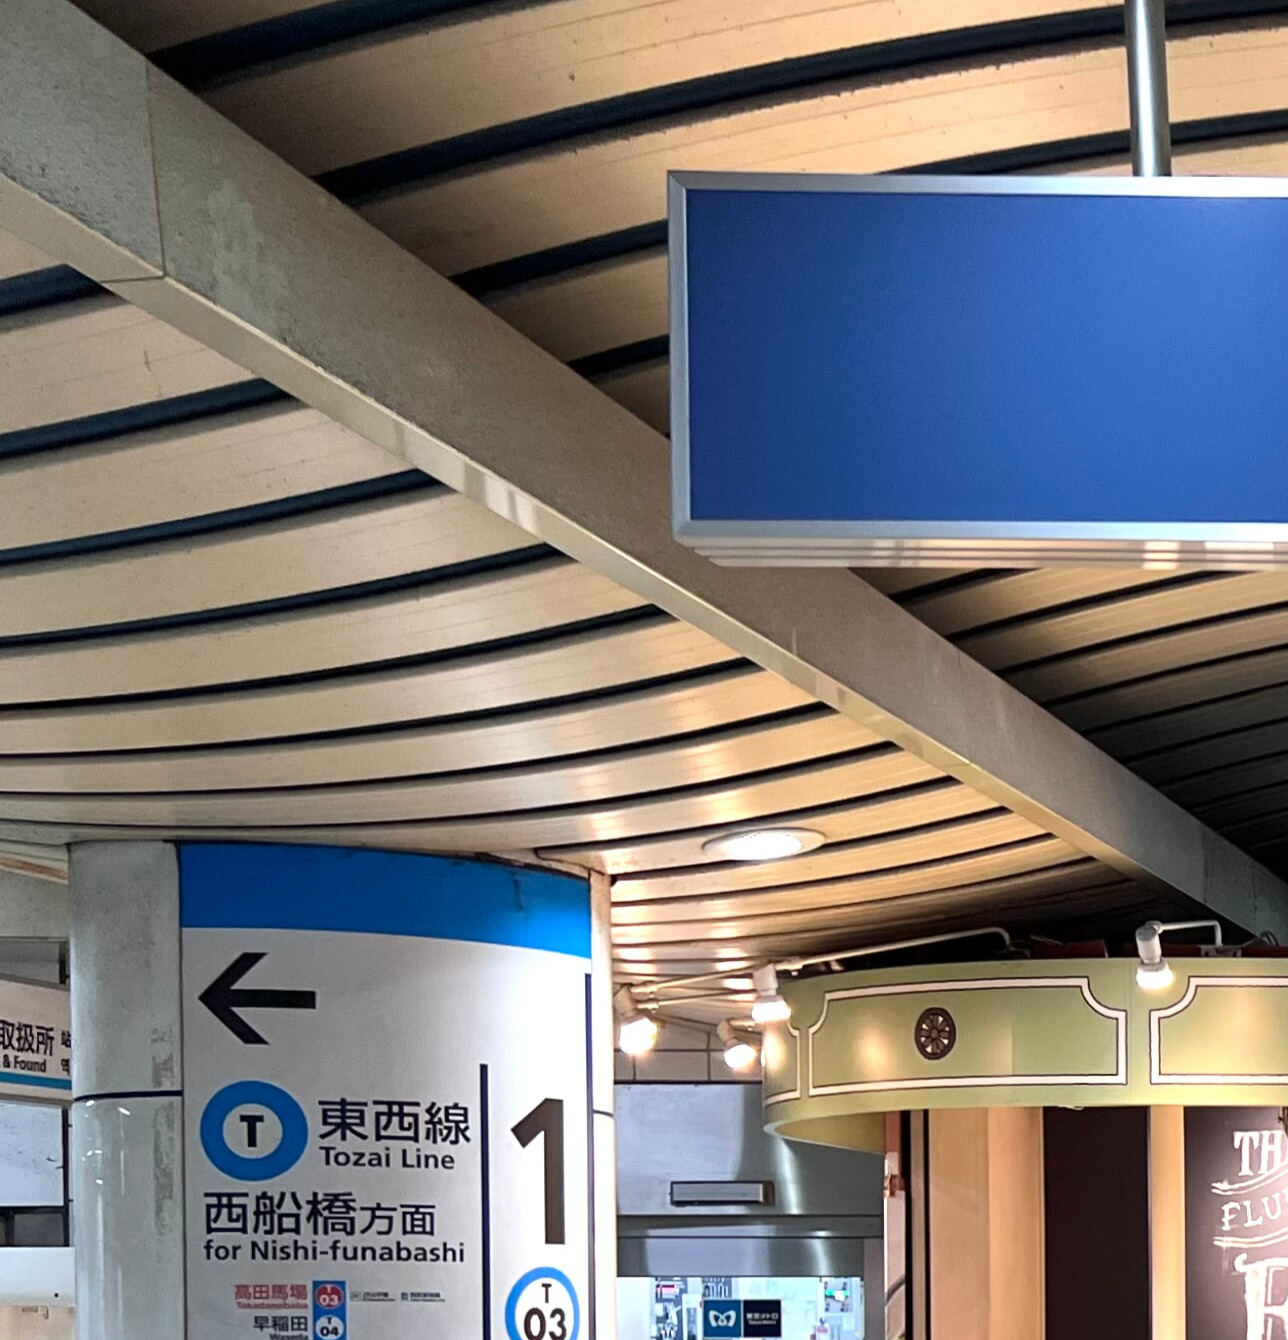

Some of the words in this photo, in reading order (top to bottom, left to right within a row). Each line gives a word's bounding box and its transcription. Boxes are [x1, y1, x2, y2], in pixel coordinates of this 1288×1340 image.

[14, 1056, 46, 1073] Found
[240, 1115, 264, 1148] T
[318, 1098, 471, 1145] 東西線
[319, 1146, 391, 1168] Tozai
[401, 1149, 455, 1170] Line
[510, 1097, 565, 1245] 1
[204, 1191, 436, 1236] 西船橋方面
[204, 1240, 242, 1263] for
[251, 1240, 465, 1263] Nishi-funabashi
[321, 1295, 339, 1306] 03
[541, 1283, 552, 1303] T
[253, 1316, 308, 1332] 早稲田
[320, 1326, 339, 1337] 04
